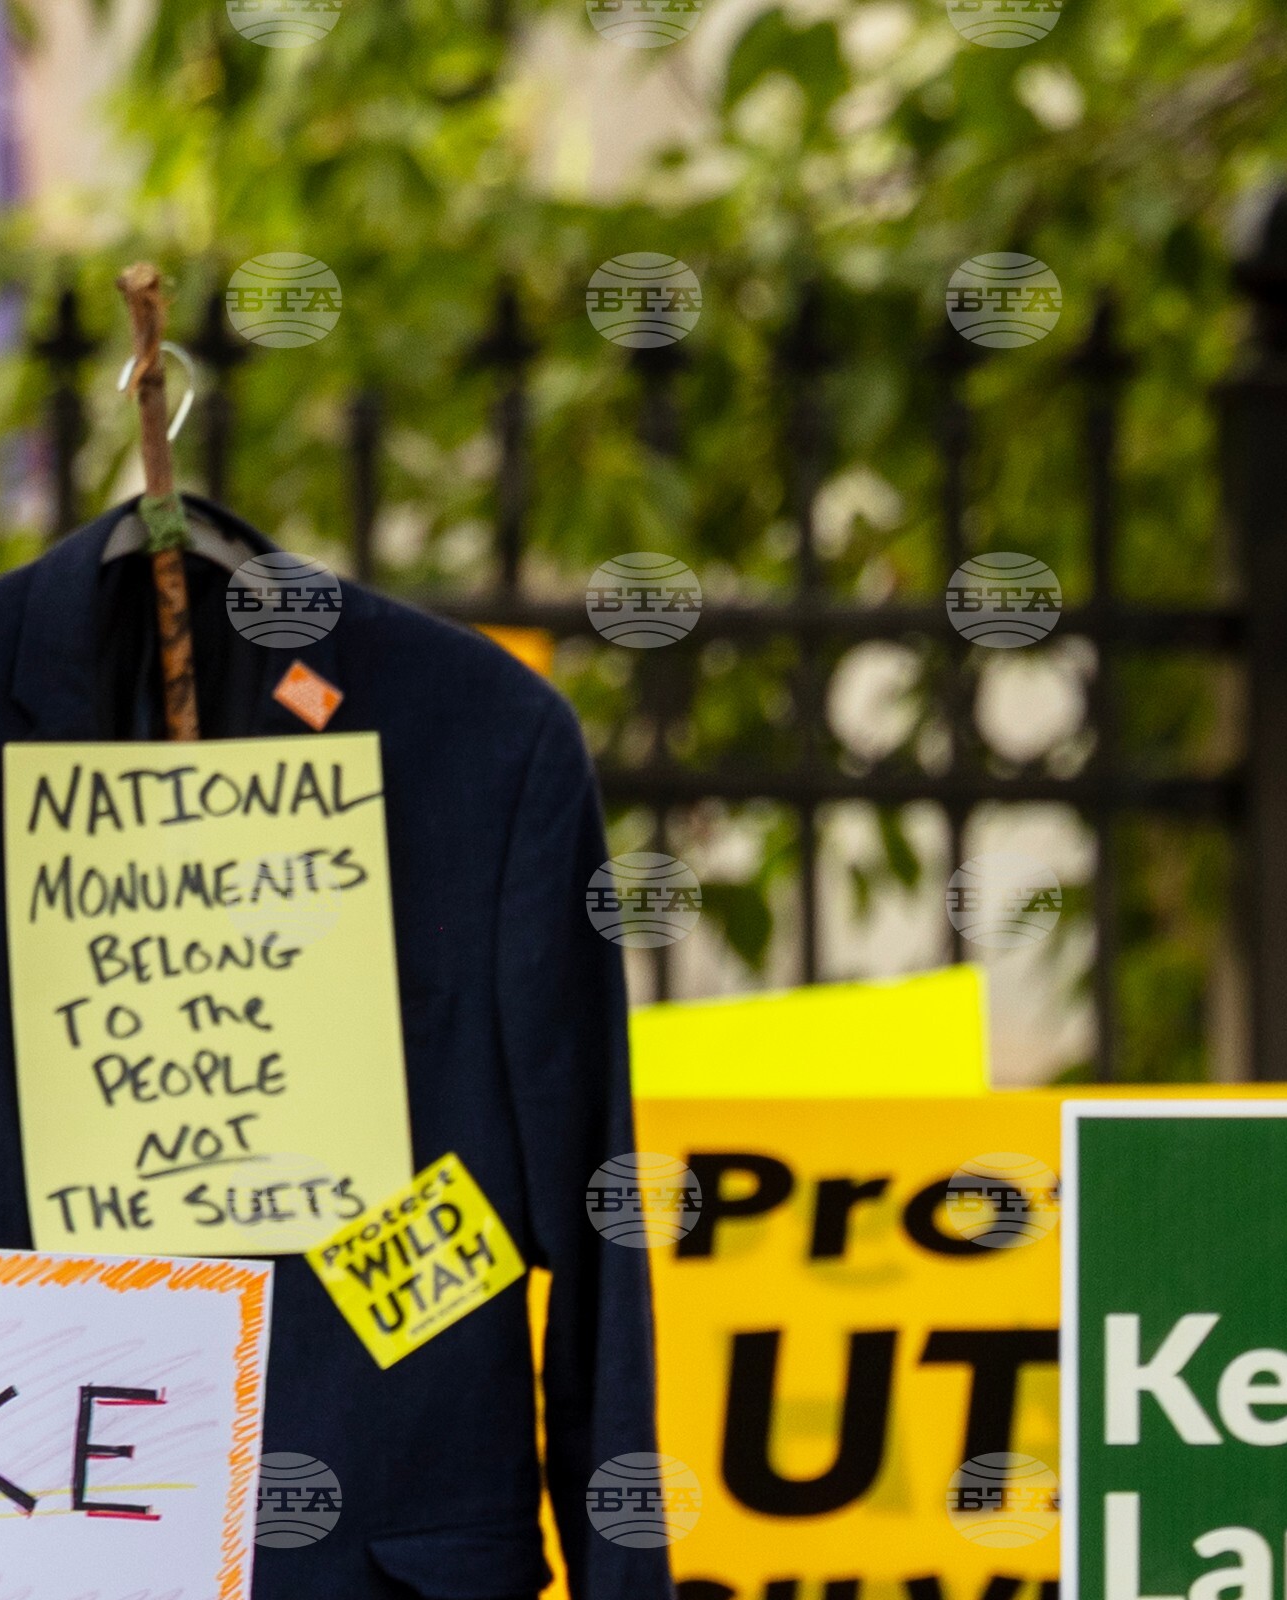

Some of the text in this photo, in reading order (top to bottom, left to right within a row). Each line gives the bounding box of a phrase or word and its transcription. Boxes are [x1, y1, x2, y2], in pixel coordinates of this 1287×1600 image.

[27, 760, 384, 834] NATIONAL
[28, 846, 369, 923] MONUMENTS
[87, 929, 304, 988] BELONG
[55, 996, 146, 1049] TO
[92, 1052, 287, 1107] PEOPLE
[134, 1113, 266, 1174] NOT
[47, 1174, 366, 1236] THE SUITS
[321, 1169, 455, 1268] Protect
[672, 1150, 1060, 1267] Pro
[345, 1202, 463, 1292] WILD
[369, 1231, 496, 1335] UTAH
